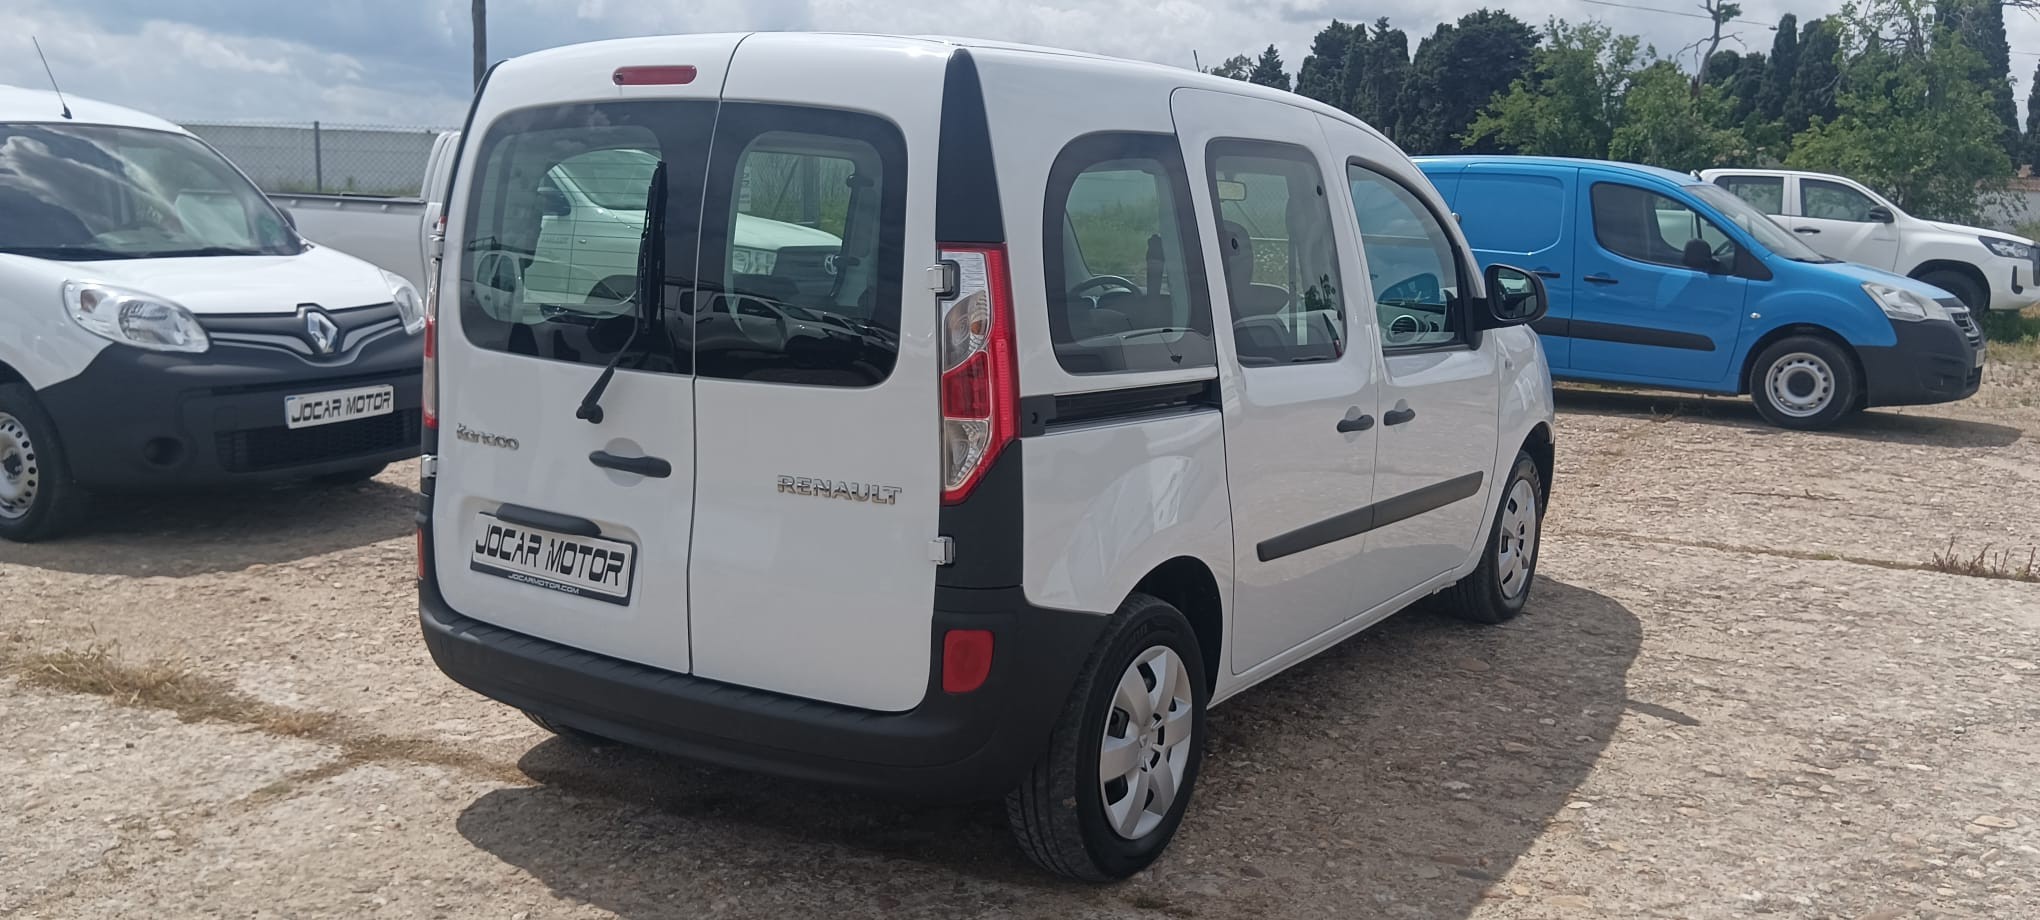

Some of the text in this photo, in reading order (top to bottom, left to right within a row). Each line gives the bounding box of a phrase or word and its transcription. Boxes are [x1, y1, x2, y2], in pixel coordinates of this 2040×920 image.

[291, 391, 391, 423] JOCAR MOTOR
[777, 474, 902, 505] RENAULT
[475, 524, 625, 586] JOCAR MOTOR
[507, 573, 580, 594] JOCARMOTOR.COM
